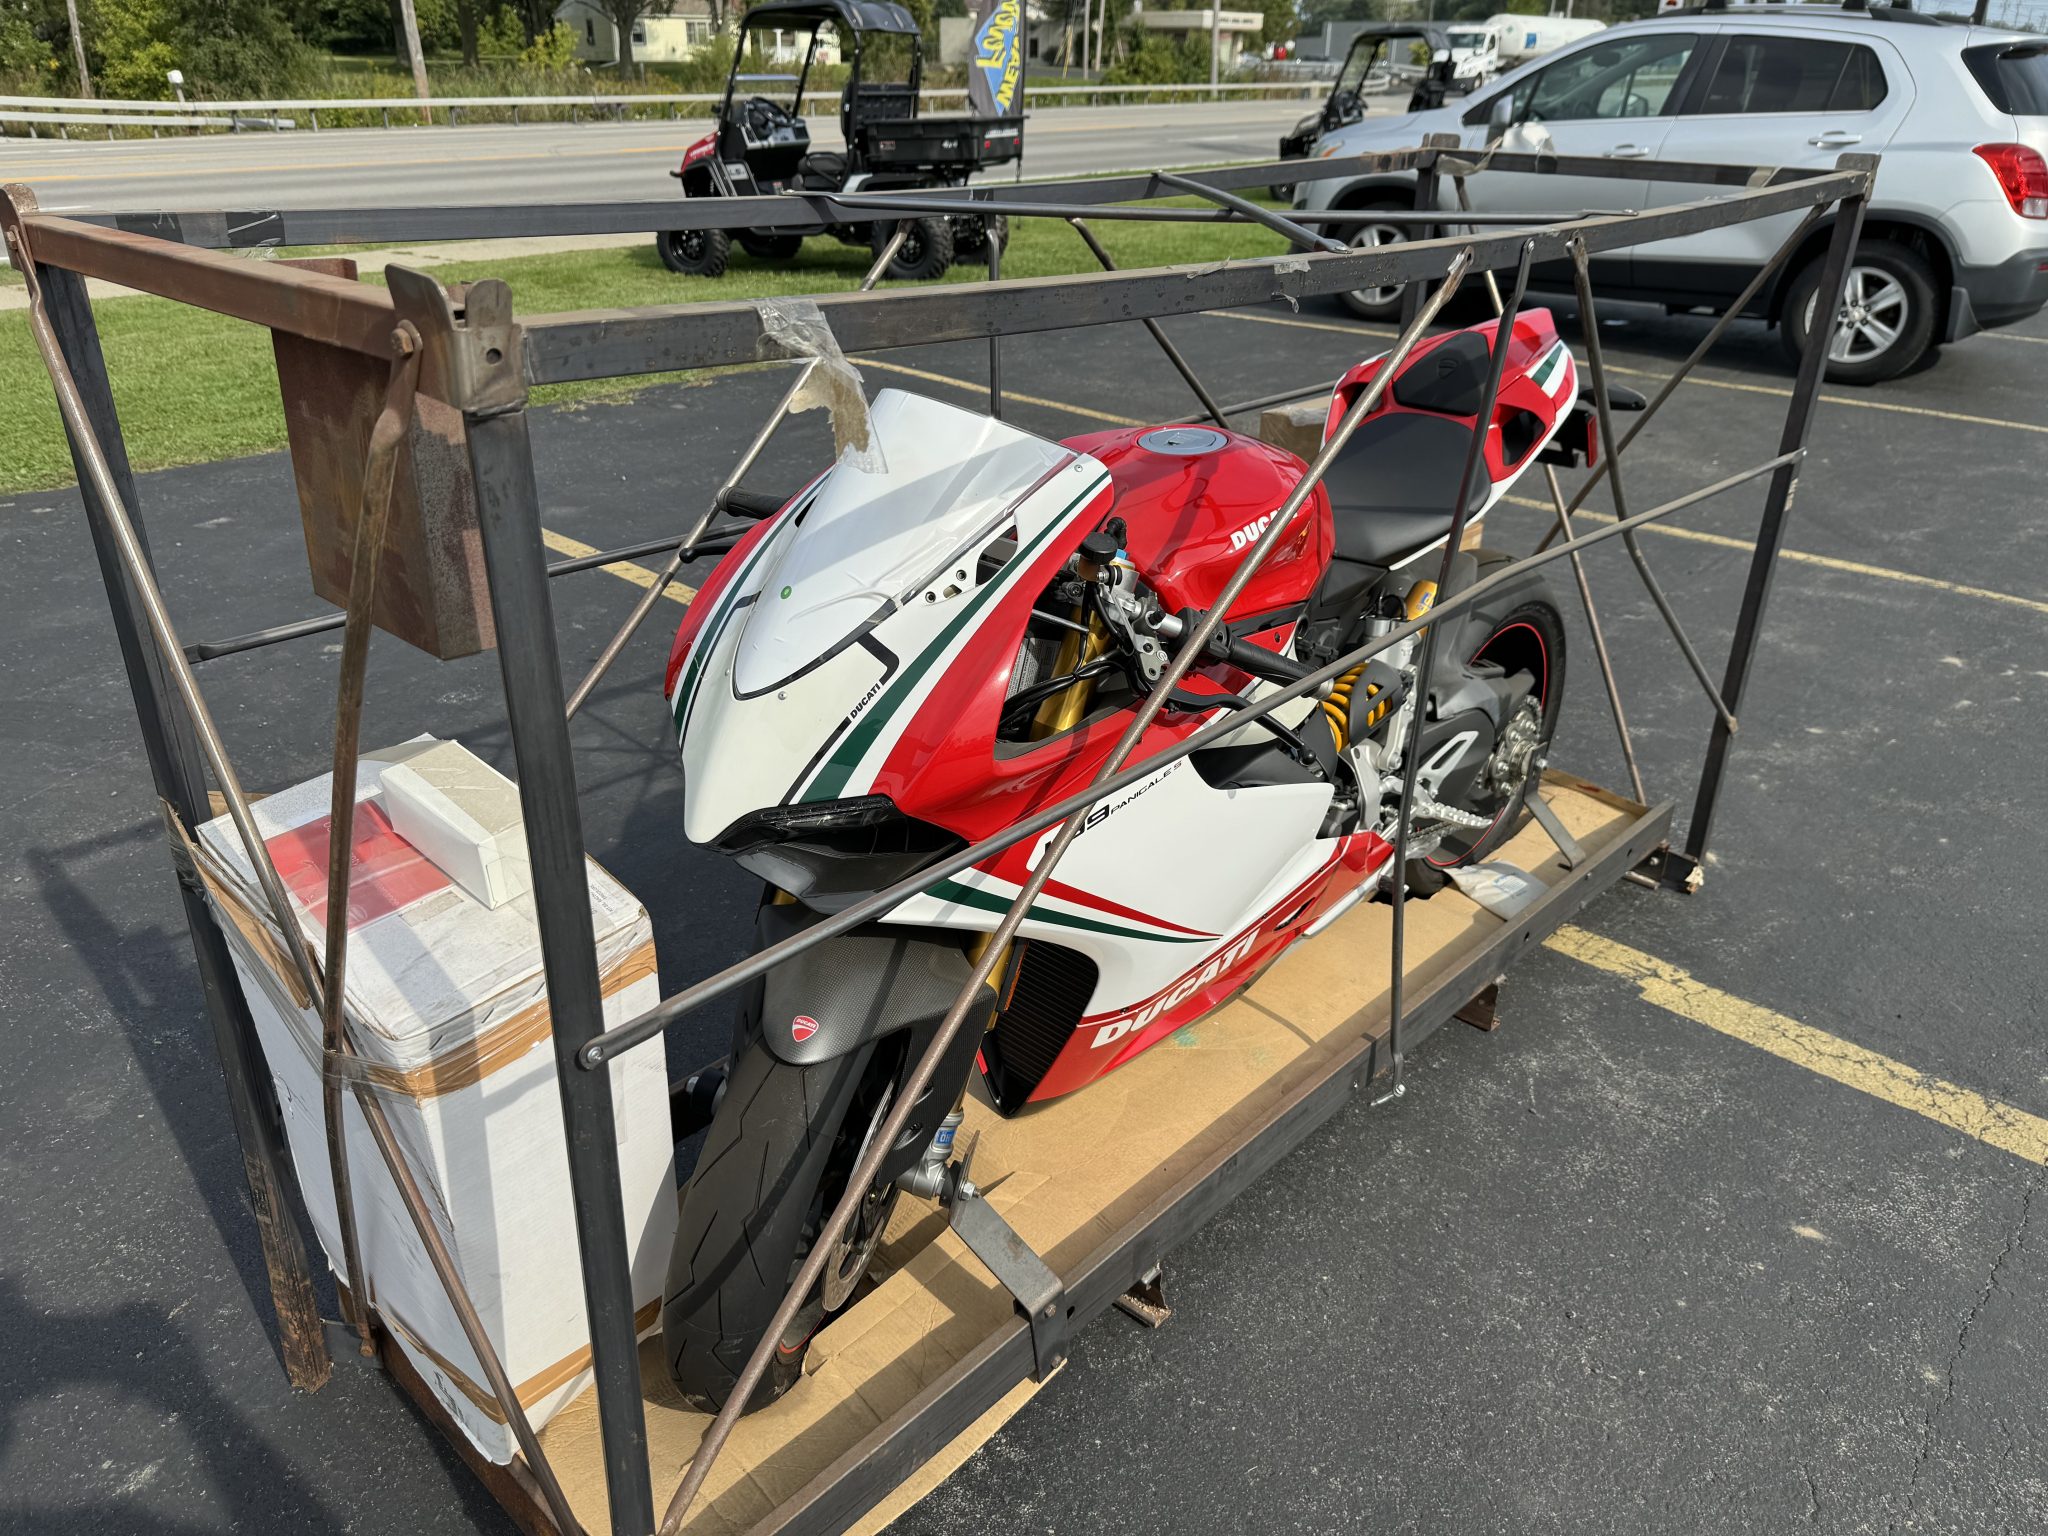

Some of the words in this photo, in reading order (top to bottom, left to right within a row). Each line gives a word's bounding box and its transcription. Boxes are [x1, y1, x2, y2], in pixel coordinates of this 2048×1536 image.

[850, 683, 881, 719] DUCATI
[1111, 767, 1172, 815] PANIGALE
[1173, 760, 1183, 771] S
[1090, 928, 1261, 1049] DUCATI
